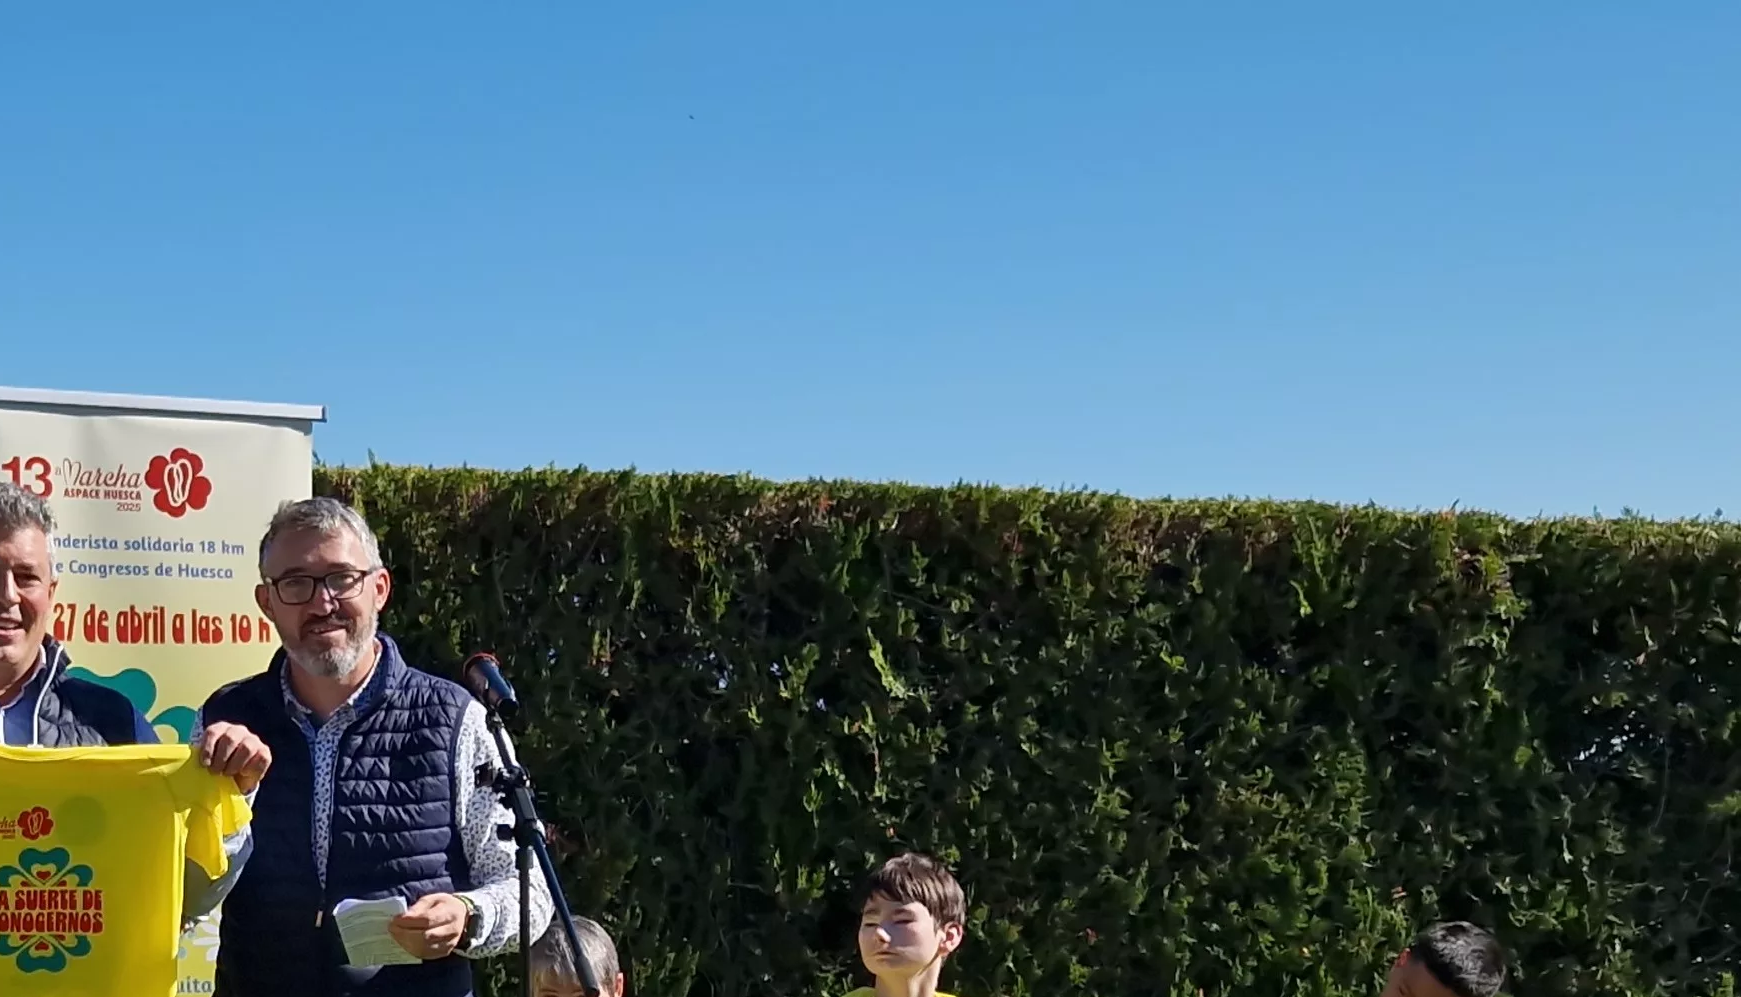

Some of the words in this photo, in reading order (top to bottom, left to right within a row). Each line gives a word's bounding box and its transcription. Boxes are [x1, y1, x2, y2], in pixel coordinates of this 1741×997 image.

[62, 457, 143, 489] Marcha
[63, 488, 101, 500] ASPACE
[103, 488, 142, 501] HUESCA
[116, 502, 142, 512] 2025
[53, 534, 119, 551] nderista
[123, 535, 195, 554] solidaria
[198, 540, 216, 554] 18
[221, 541, 245, 556] km
[55, 562, 64, 573] e
[69, 559, 150, 579] Congresos
[155, 562, 173, 577] de
[178, 563, 234, 579] Huesca
[53, 603, 77, 642] 27
[83, 603, 109, 644] de
[115, 604, 166, 645] abril
[171, 613, 185, 645] a
[191, 608, 224, 645] las
[230, 613, 252, 644] 10
[14, 889, 78, 911] SUERTE
[82, 889, 103, 911] DE
